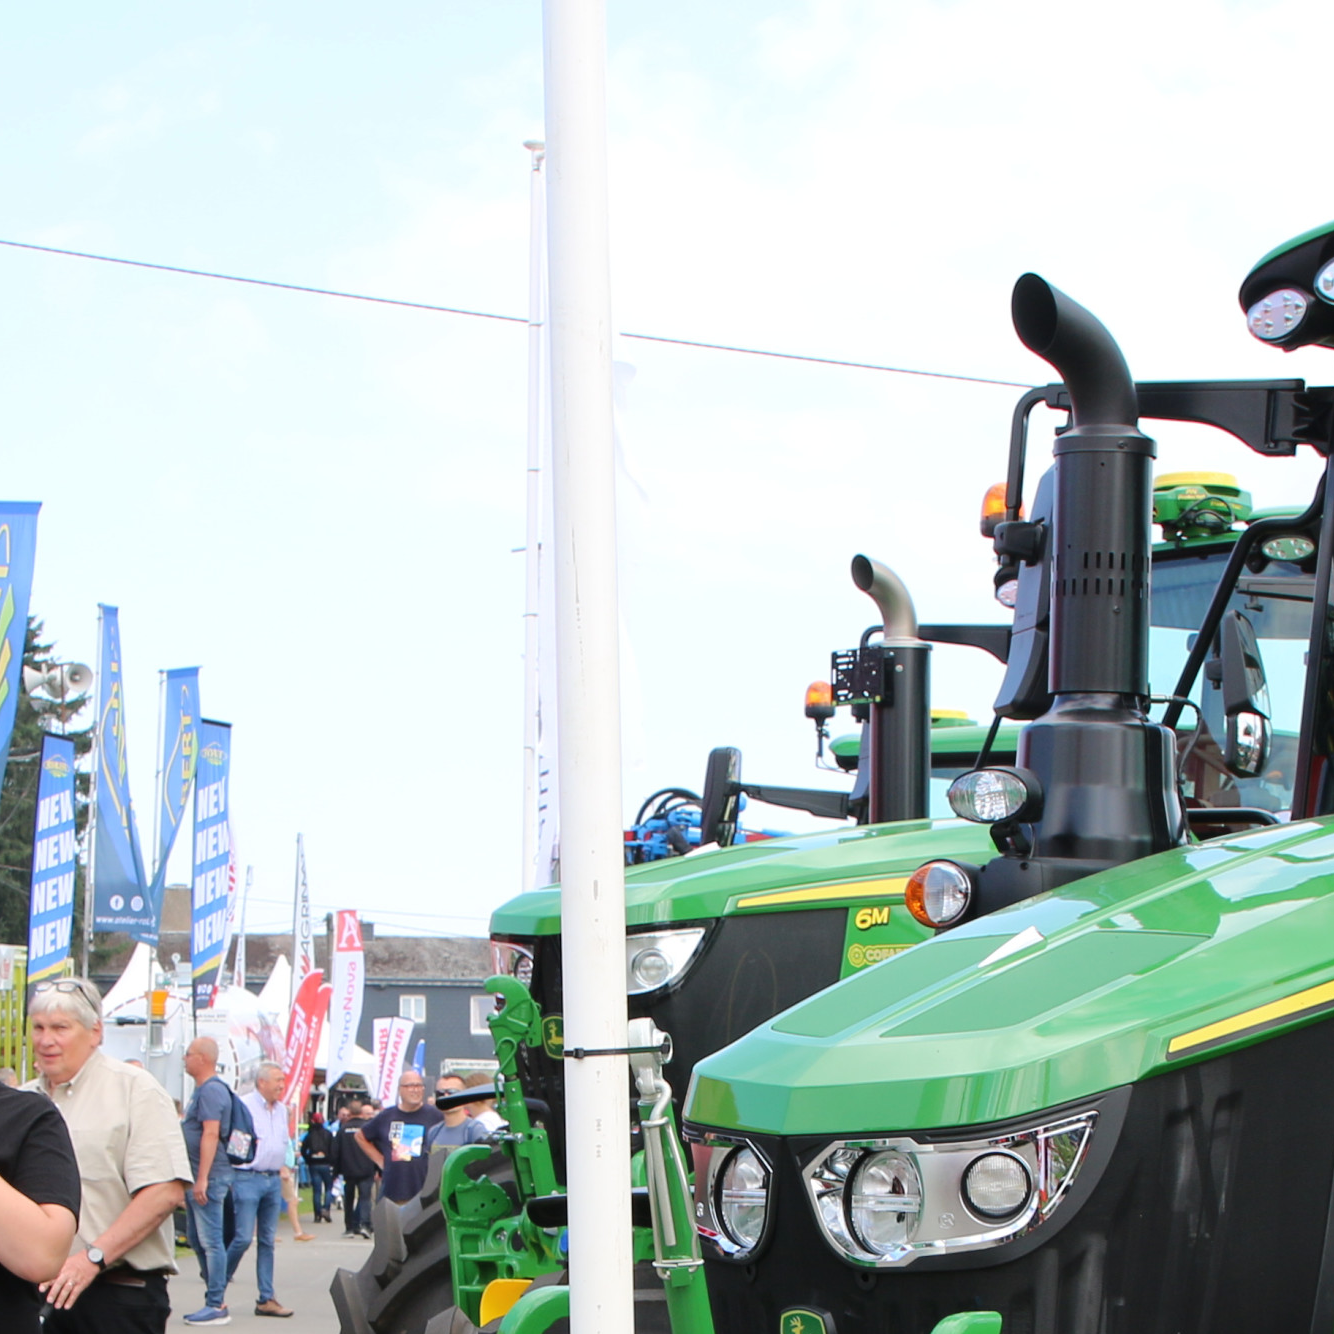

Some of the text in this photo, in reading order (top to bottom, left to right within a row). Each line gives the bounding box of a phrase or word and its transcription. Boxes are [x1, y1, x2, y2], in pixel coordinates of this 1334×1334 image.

[35, 828, 75, 873] NEW
[196, 820, 230, 865] NEW
[33, 871, 74, 916] NEW
[195, 864, 229, 910] NEW
[30, 915, 72, 961] NEW
[194, 908, 226, 955] NEW
[339, 912, 361, 948] A
[854, 906, 890, 931] 6M
[381, 1027, 405, 1101] YANMAR
